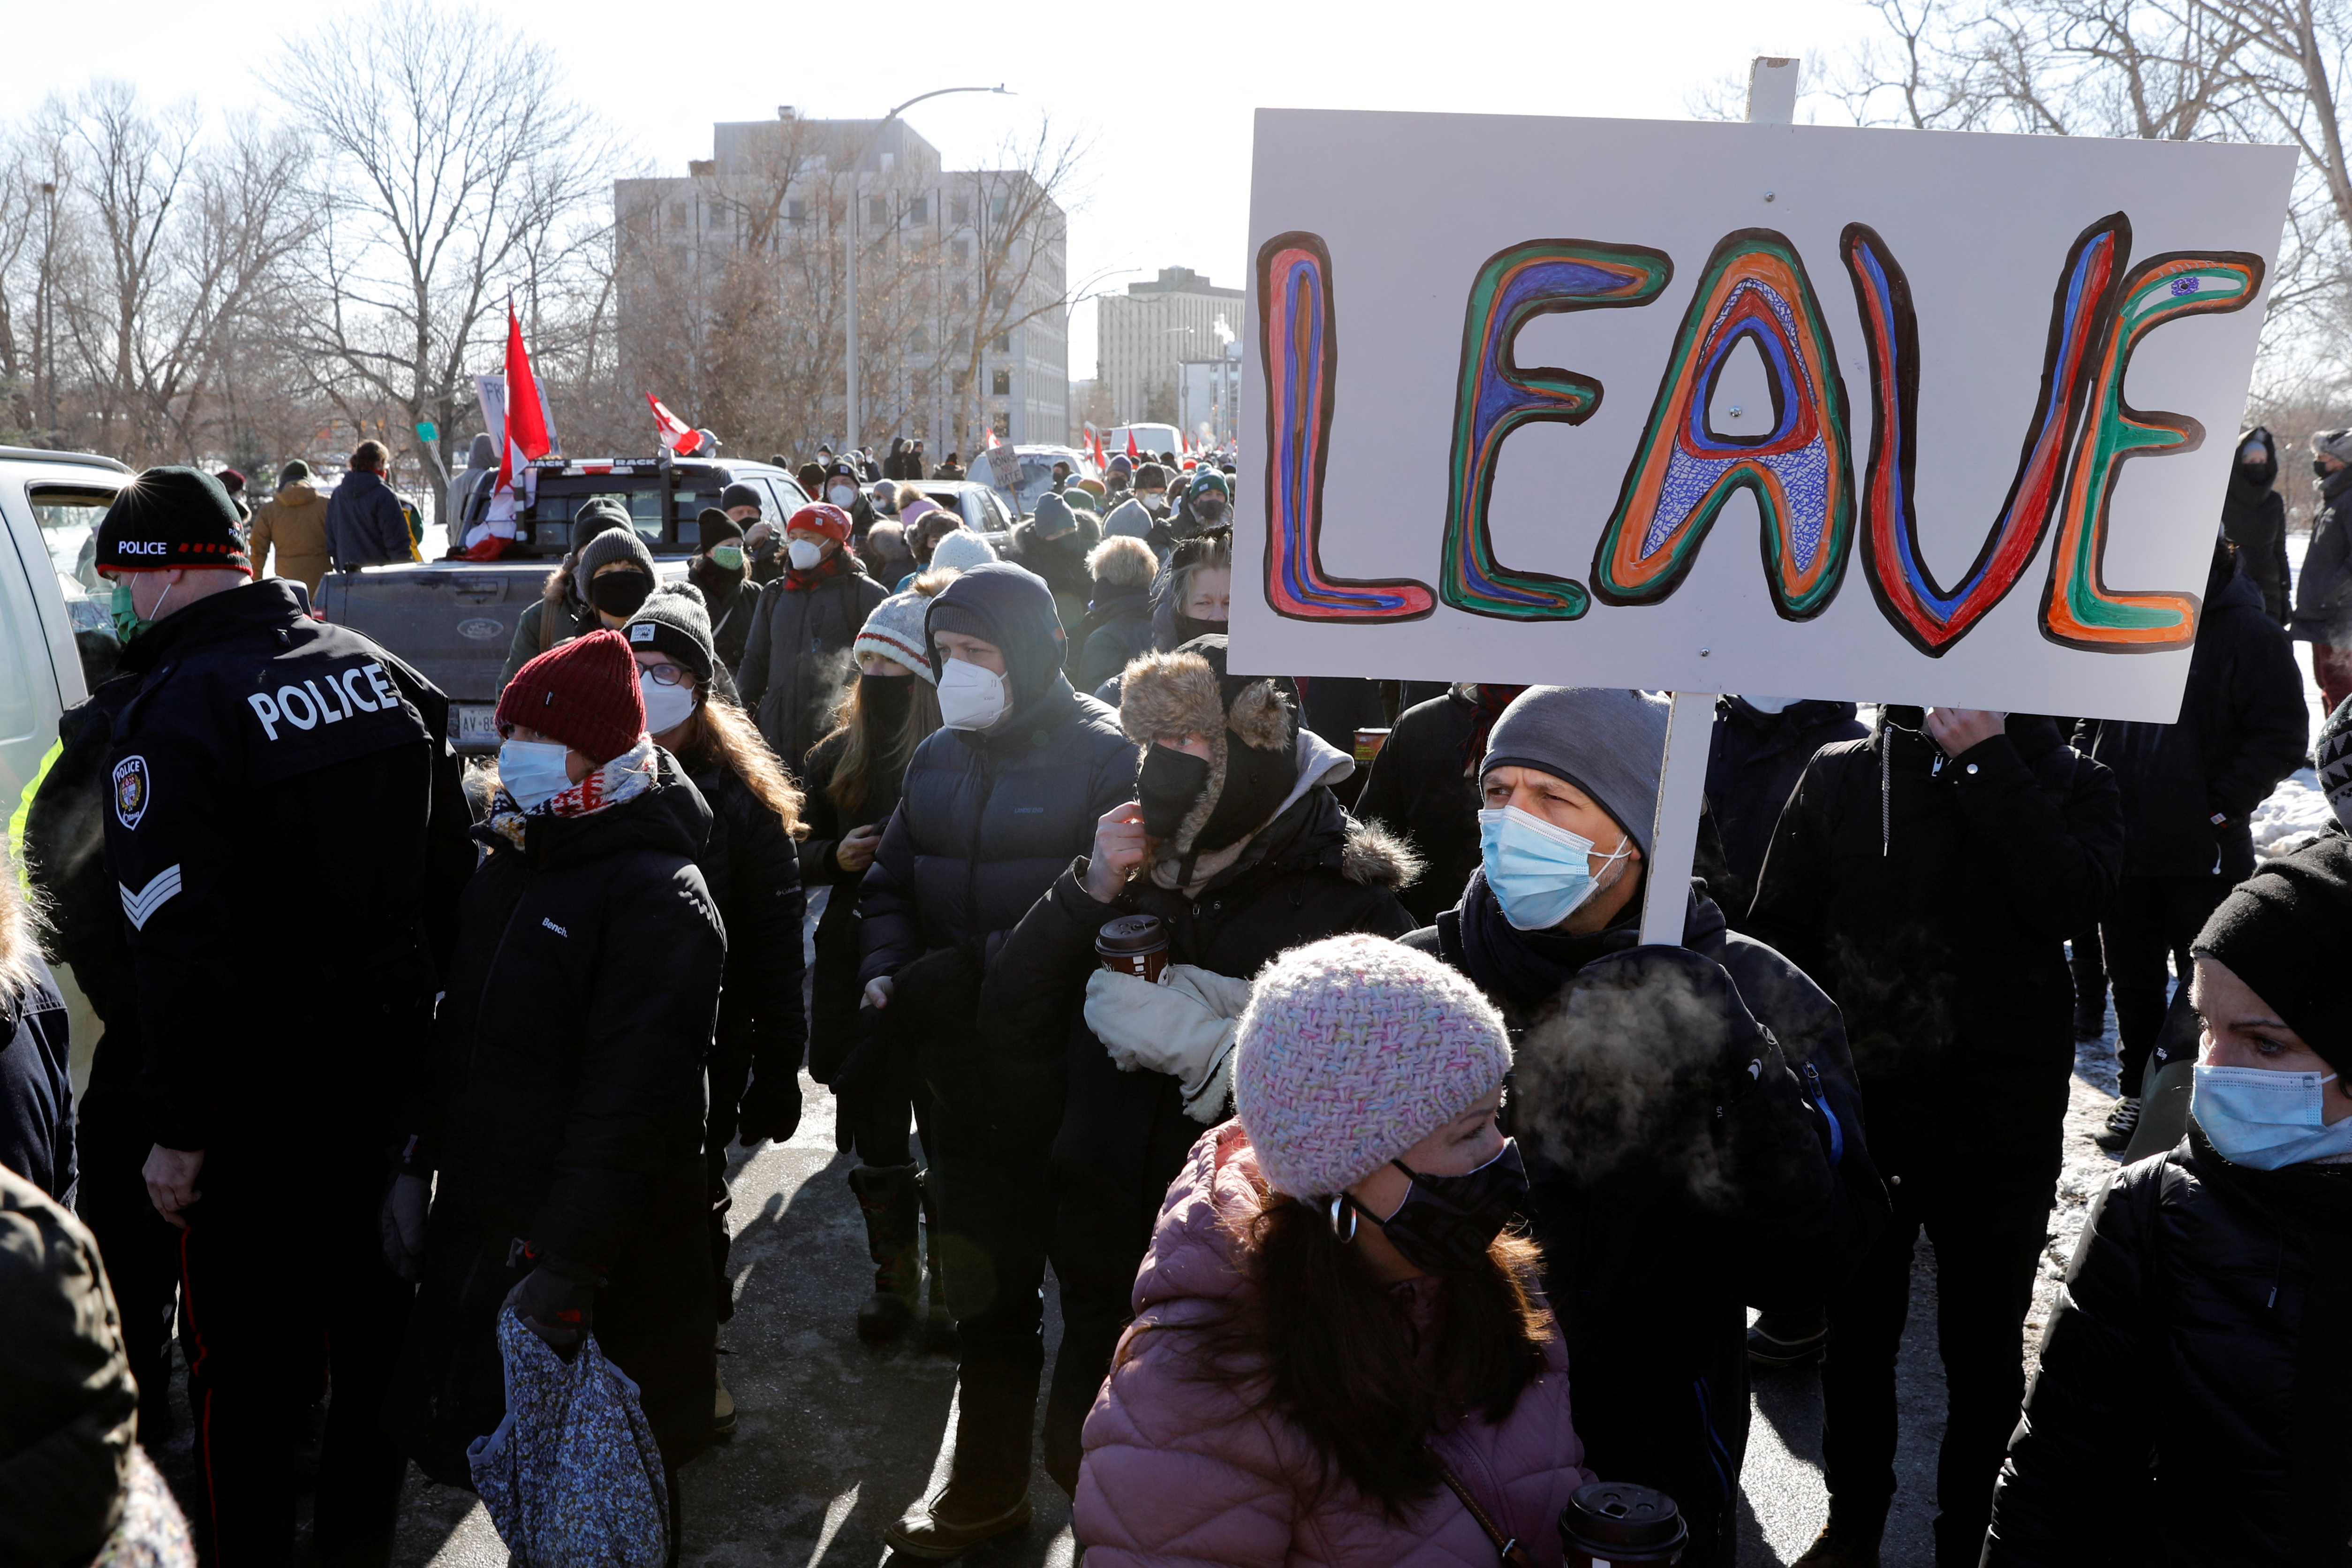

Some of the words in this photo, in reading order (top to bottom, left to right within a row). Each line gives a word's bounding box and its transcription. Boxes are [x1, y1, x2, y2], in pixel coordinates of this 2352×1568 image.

[1256, 211, 2266, 659] LEAVE
[988, 452, 1017, 468] HONKS
[996, 470, 1021, 485] HATE
[119, 540, 167, 555] POLICE
[247, 663, 399, 741] POLICE
[117, 761, 140, 783] POLICE
